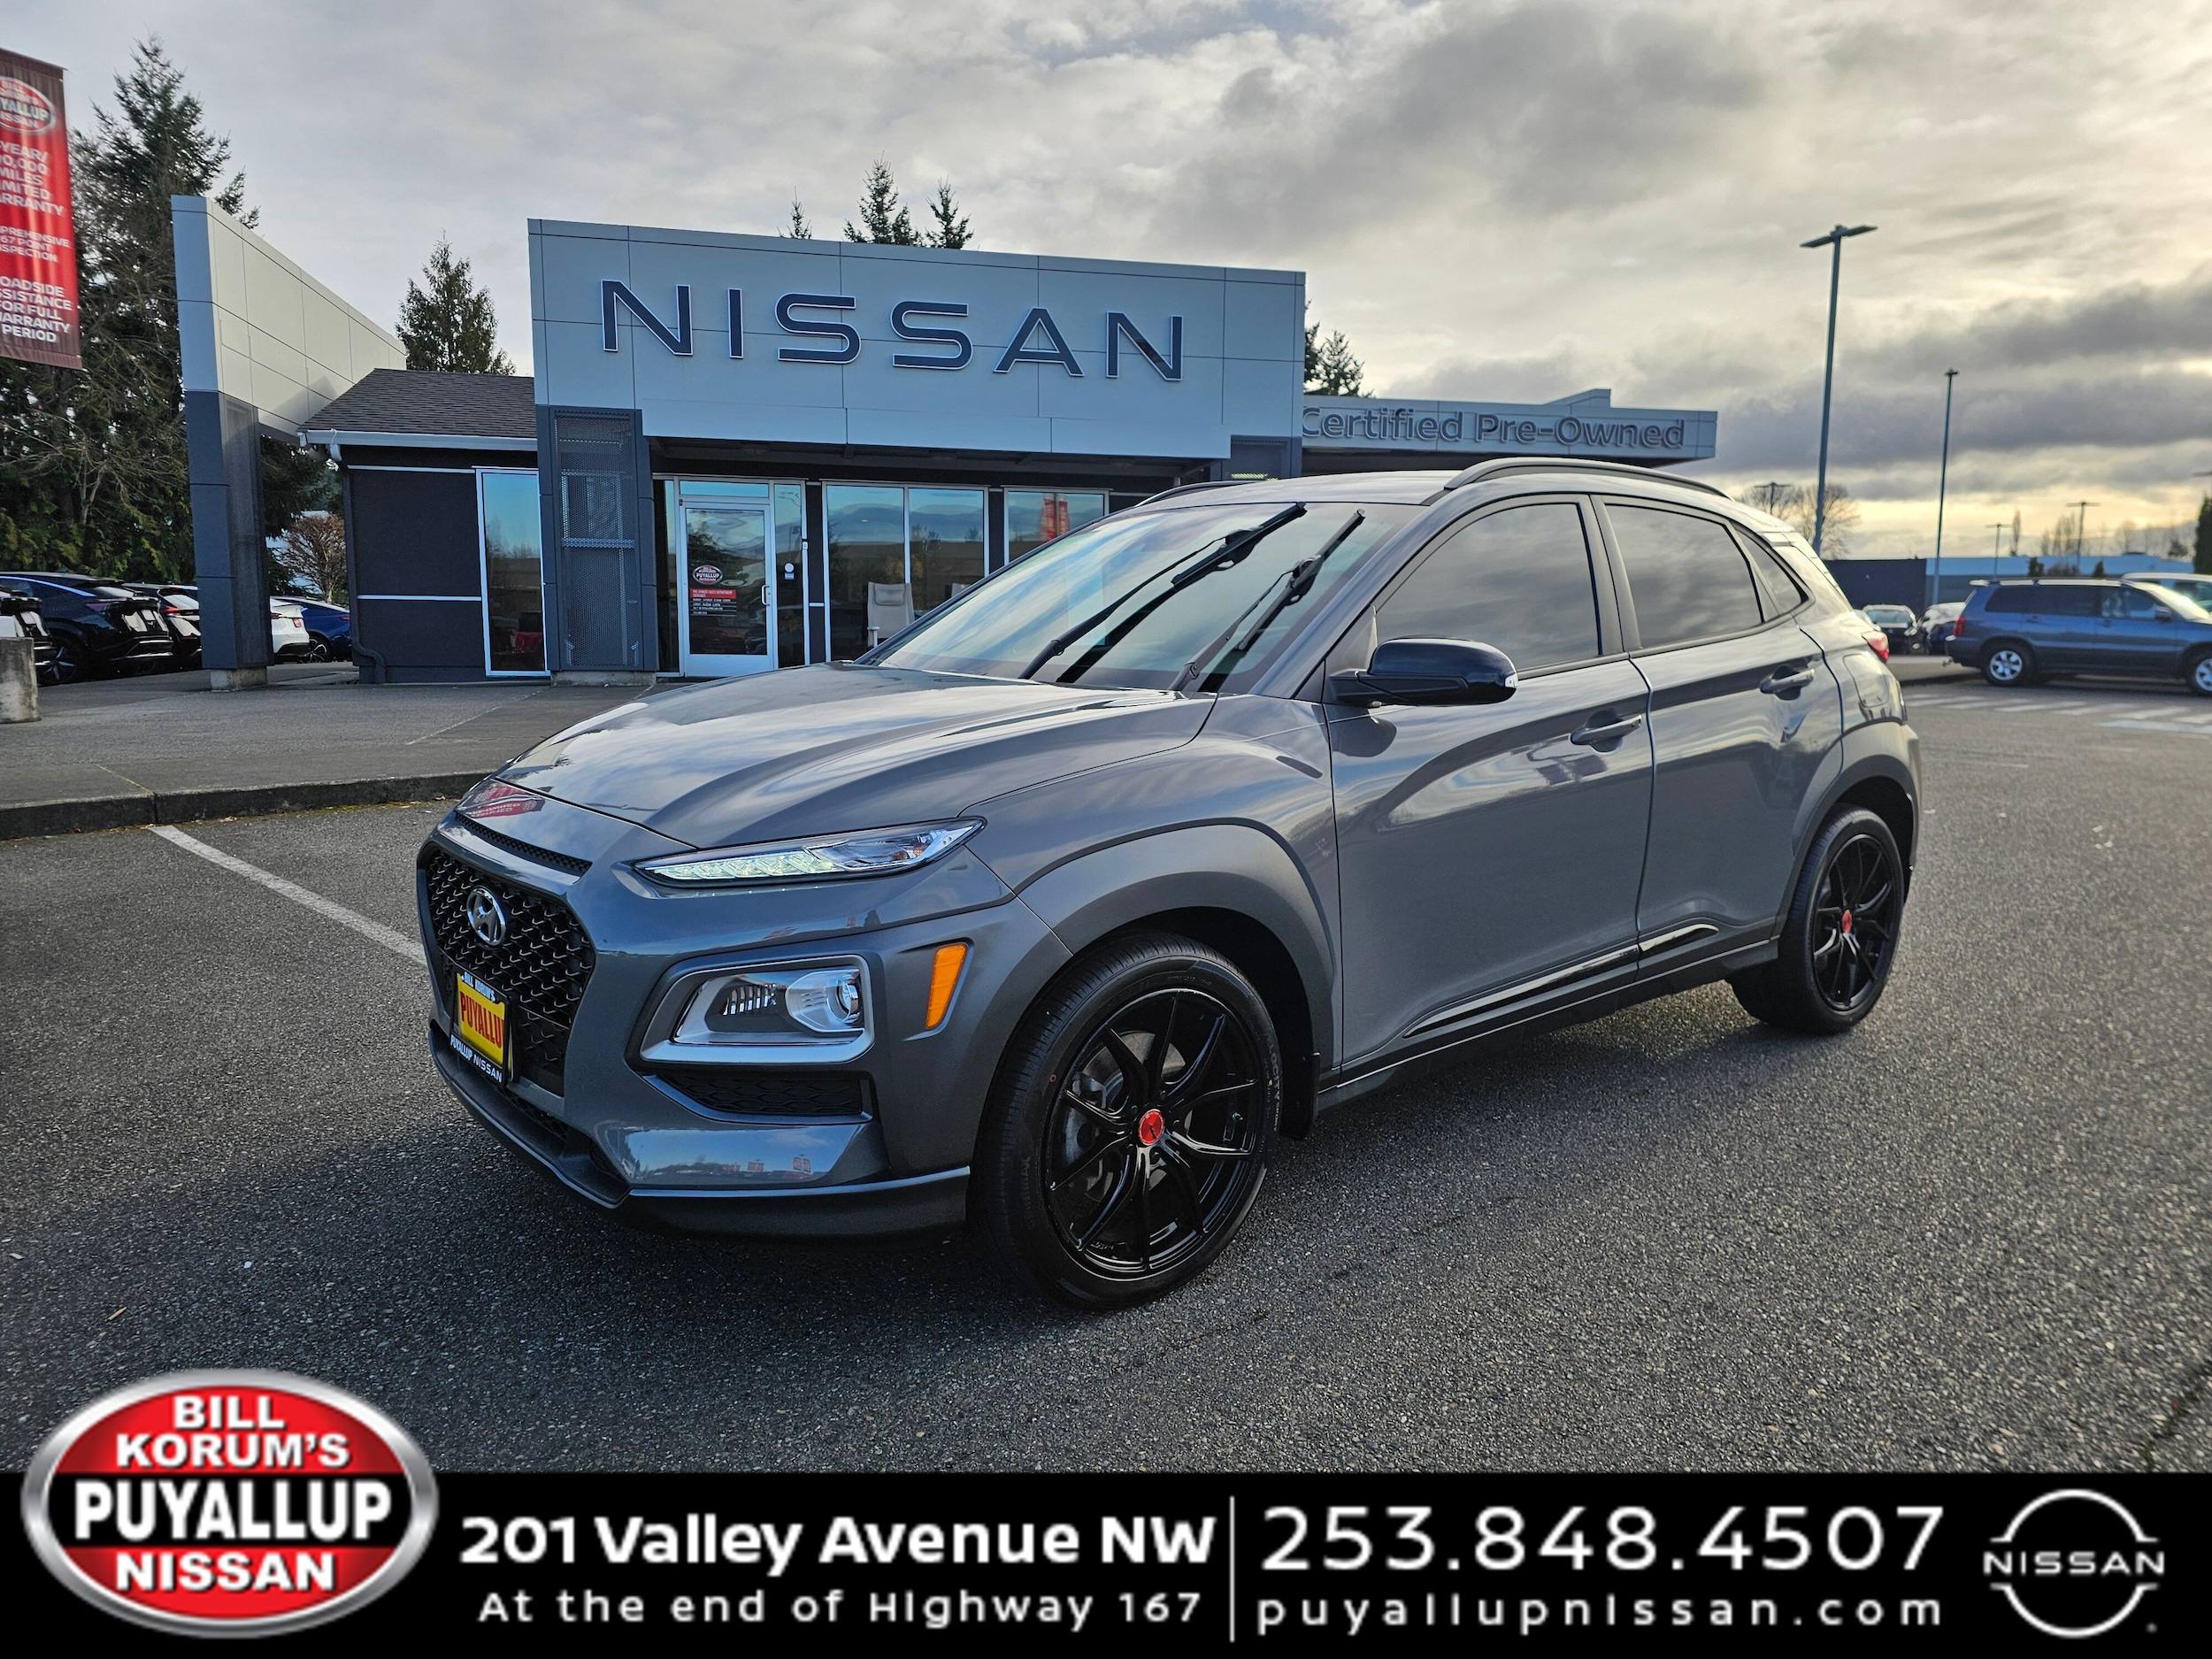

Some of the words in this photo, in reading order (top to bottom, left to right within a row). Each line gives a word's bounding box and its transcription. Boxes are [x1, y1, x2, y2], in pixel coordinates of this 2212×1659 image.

[0, 97, 50, 121] YALLUP
[0, 111, 38, 129] ISSAN
[0, 243, 58, 263] SPECTION
[0, 276, 65, 298] OADSIDE
[0, 288, 73, 311] SISTANCE
[0, 311, 71, 334] ARRANTY
[27, 303, 62, 321] FULL
[2, 324, 58, 343] PERIOD
[600, 280, 1183, 381] NISSAN
[1302, 406, 1464, 442] Certified
[1476, 413, 1686, 449] Pre-Owned
[459, 990, 504, 1049] PUYALLU
[450, 1033, 474, 1062] PUYALLUP
[472, 1053, 503, 1083] NISSAN
